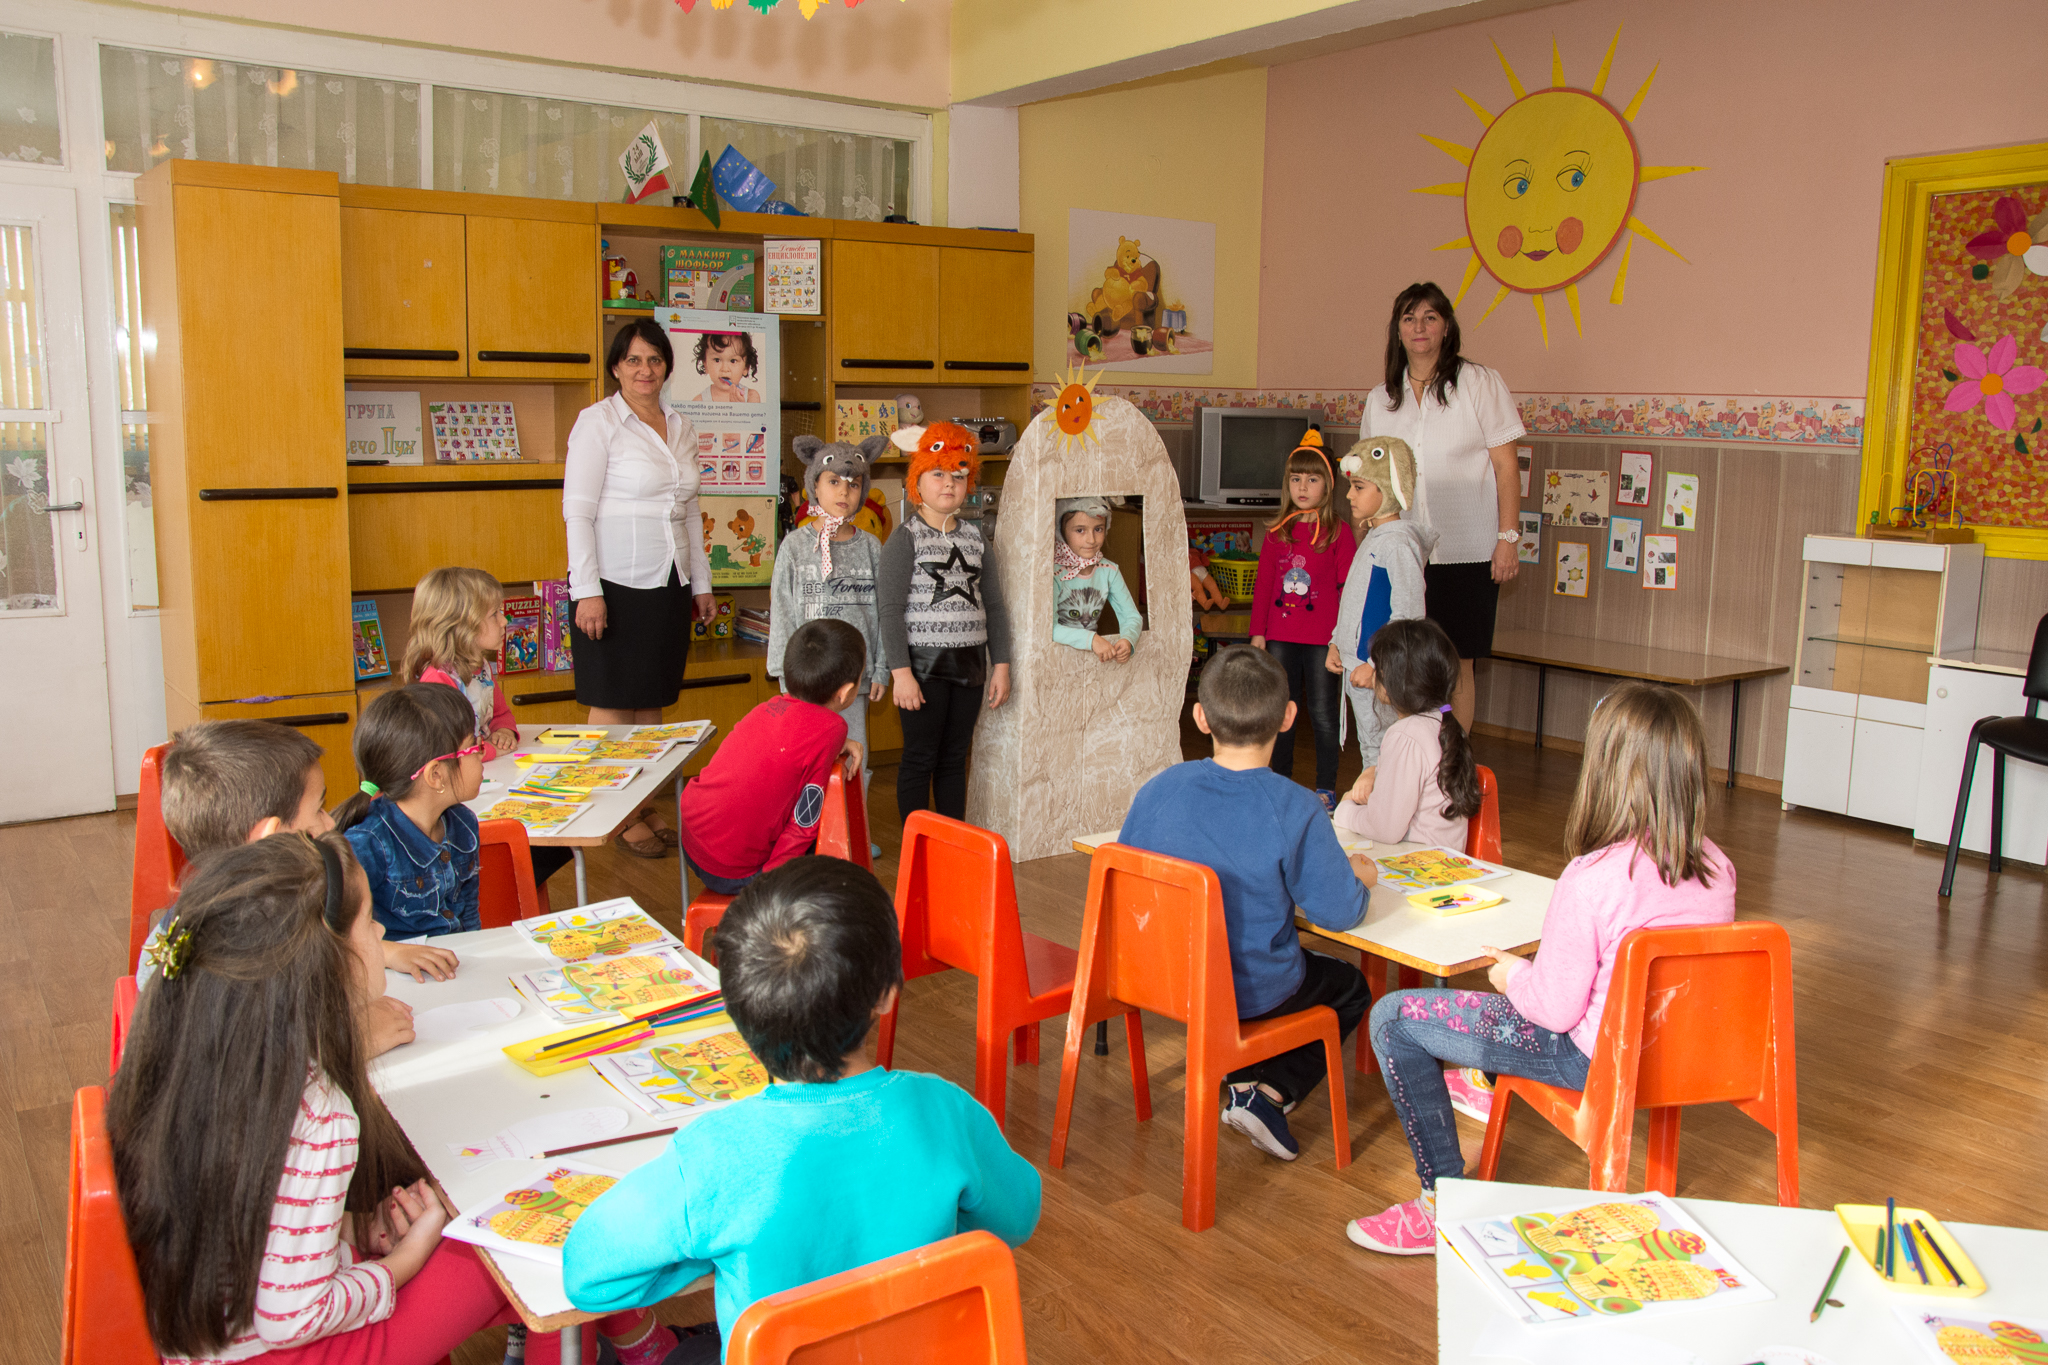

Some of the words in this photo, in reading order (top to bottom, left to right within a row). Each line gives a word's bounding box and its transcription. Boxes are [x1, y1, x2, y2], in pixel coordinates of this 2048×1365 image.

[680, 250, 731, 260] МАЛКИЯТ
[768, 252, 817, 260] ЕНЦИКЛОПЕДИЯ
[675, 260, 724, 270] ШОФЬОР
[346, 404, 395, 419] ГРУПА
[849, 407, 853, 415] 1
[870, 406, 874, 414] 2
[890, 407, 895, 415] 3
[850, 424, 854, 432] 4
[871, 424, 876, 432] 5
[346, 440, 377, 454] ечо
[828, 576, 876, 596] Forever
[505, 600, 540, 611] PUZZLE
